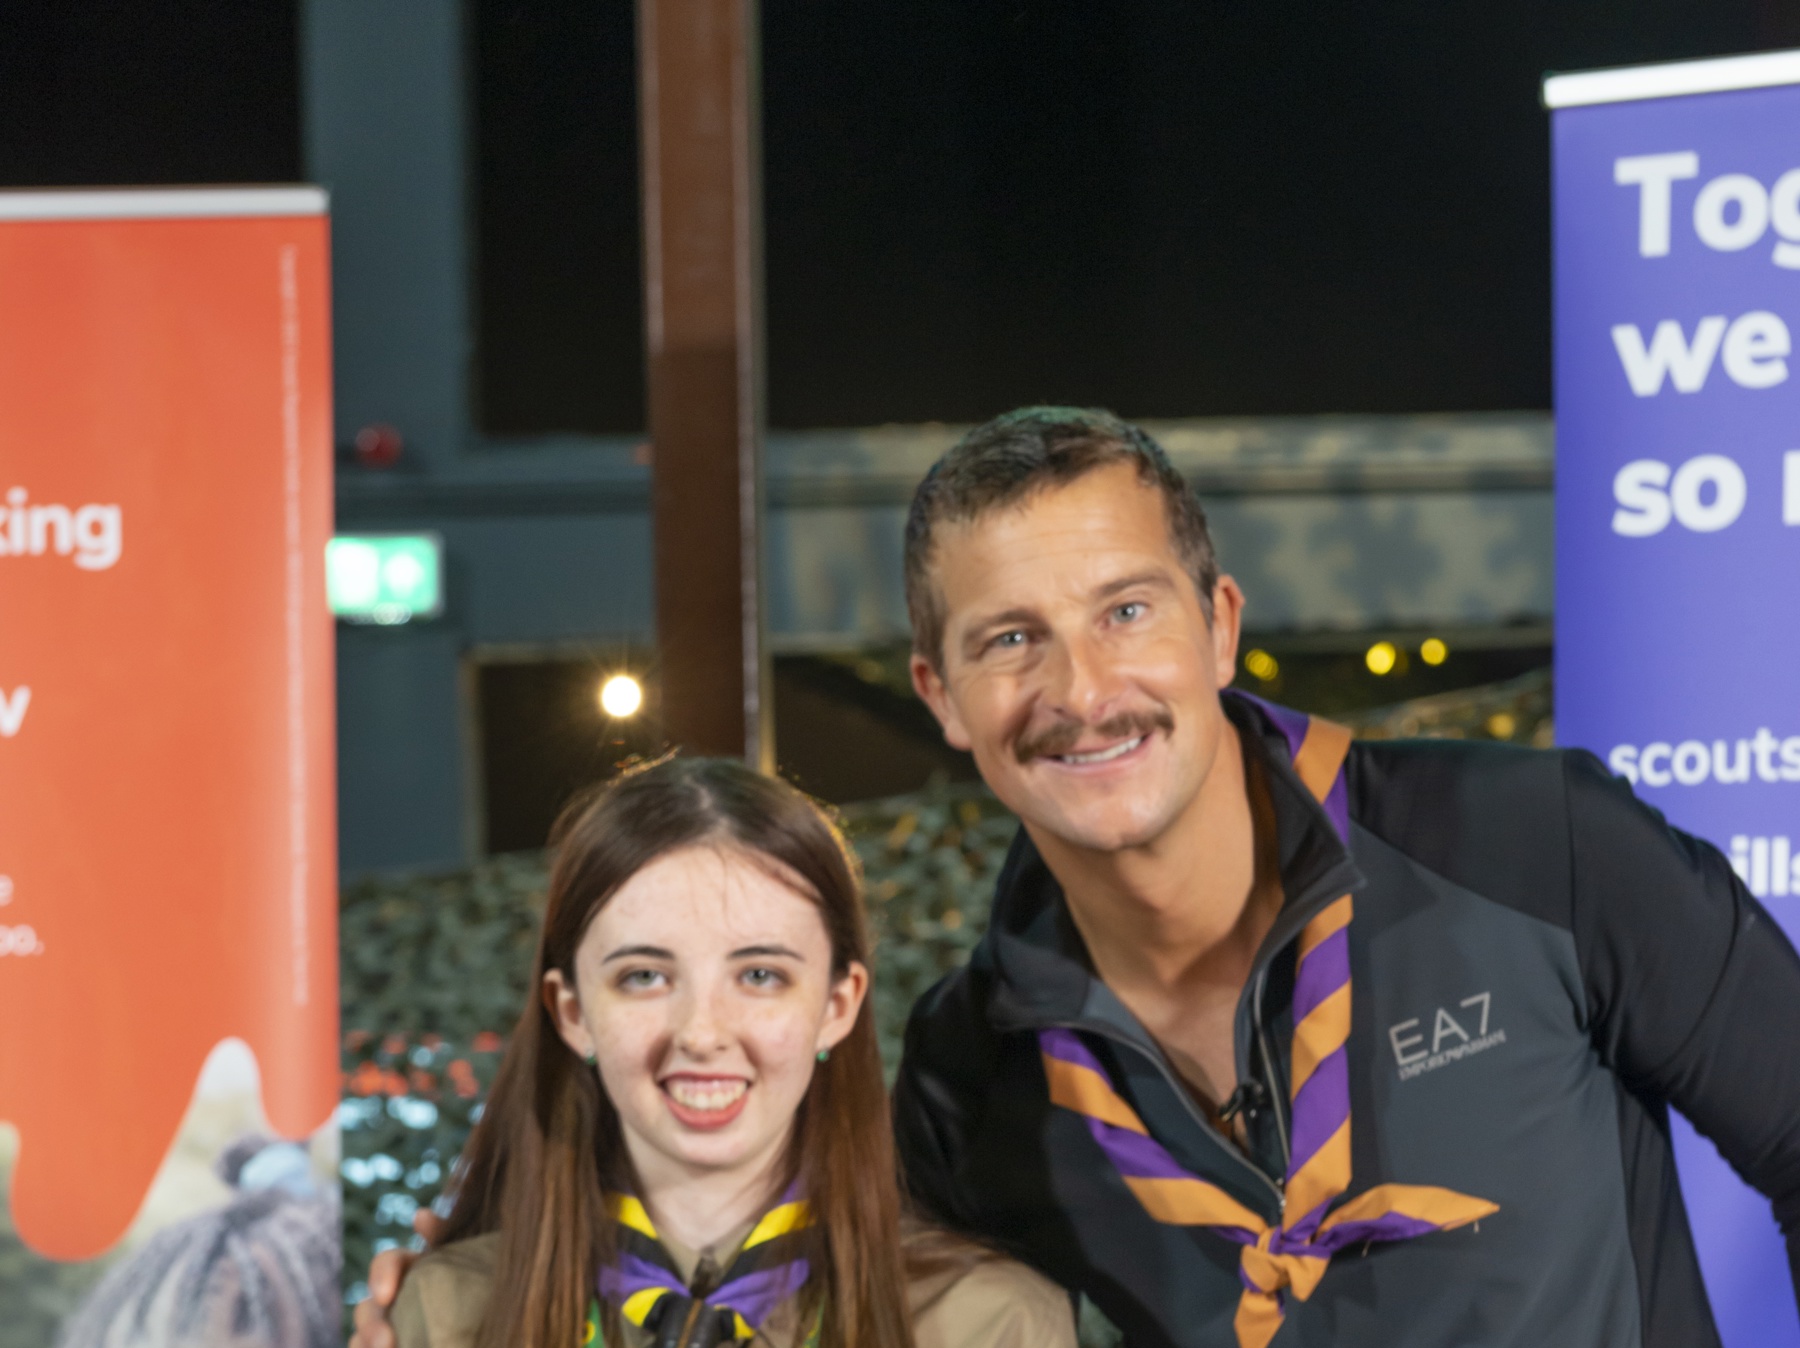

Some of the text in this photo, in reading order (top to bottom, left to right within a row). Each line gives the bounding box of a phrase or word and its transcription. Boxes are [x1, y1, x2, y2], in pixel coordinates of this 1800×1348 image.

[1611, 310, 1791, 398] we
[0, 486, 122, 571] ing
[1611, 453, 1747, 538] so
[1389, 991, 1491, 1066] EA7
